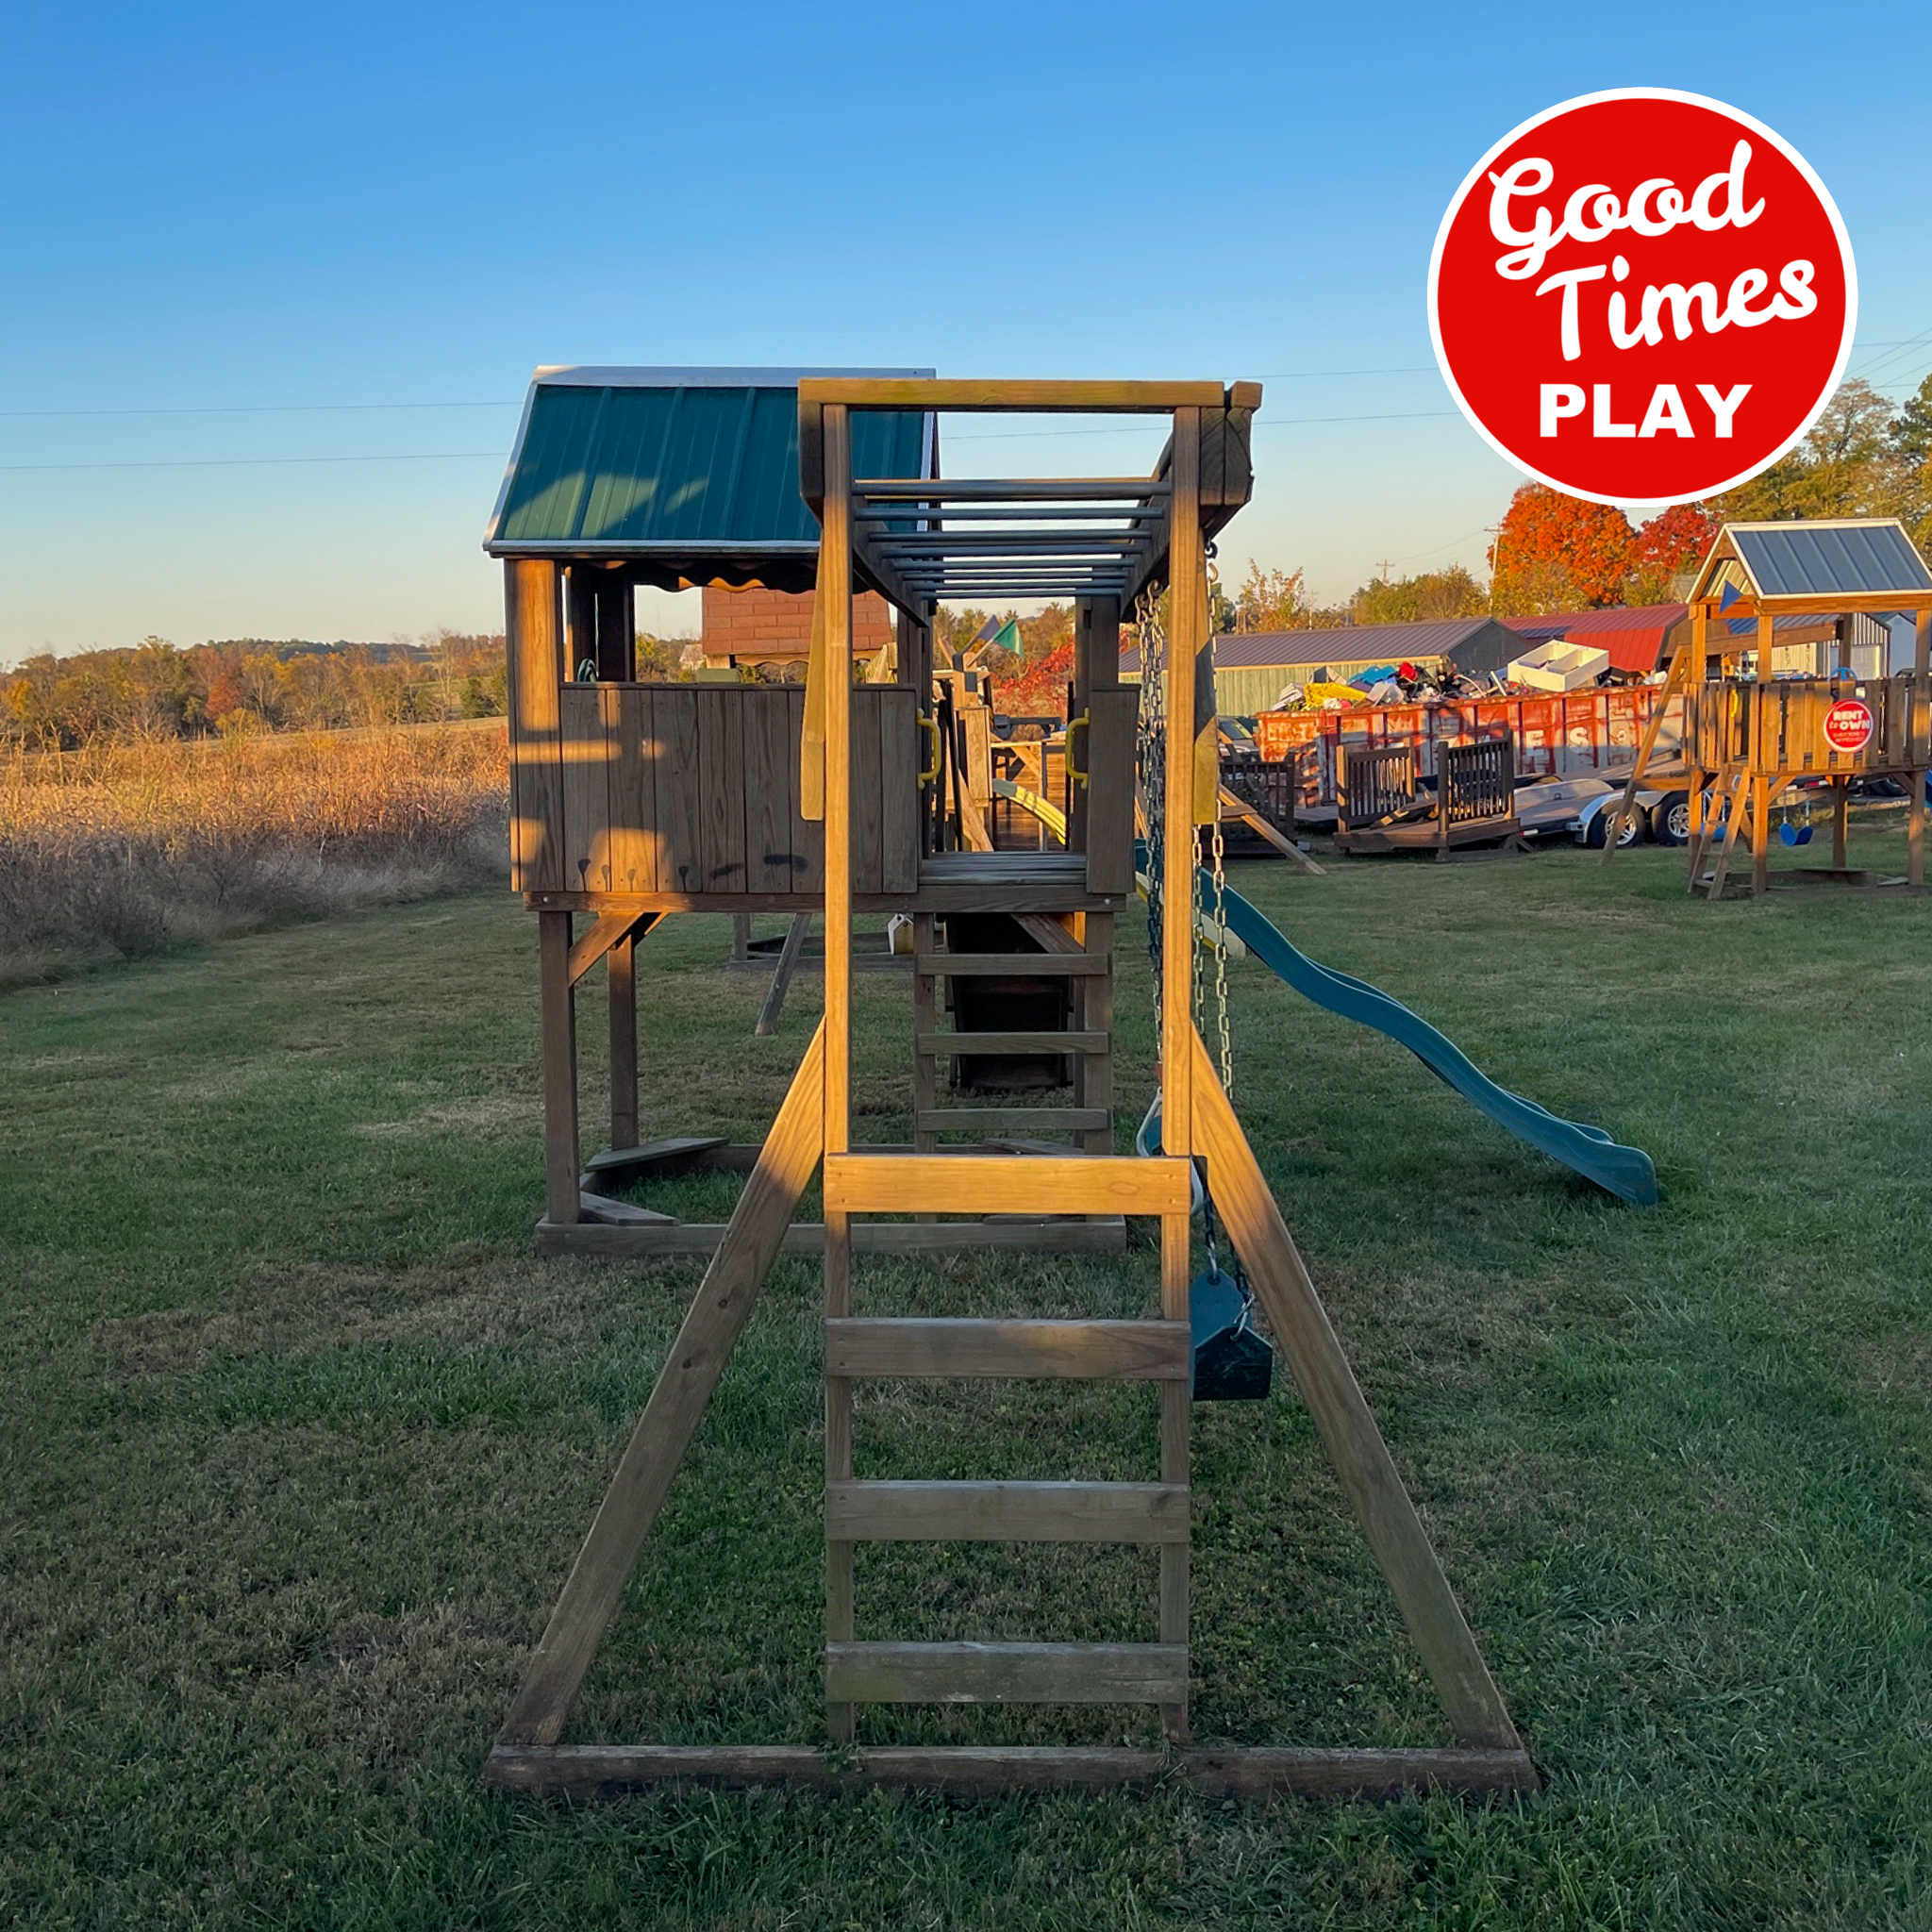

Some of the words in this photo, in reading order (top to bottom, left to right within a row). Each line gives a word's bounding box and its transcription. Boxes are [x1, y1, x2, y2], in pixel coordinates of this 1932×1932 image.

[1833, 710, 1864, 722] RENT
[1829, 721, 1839, 729] to
[1840, 720, 1871, 730] OWN
